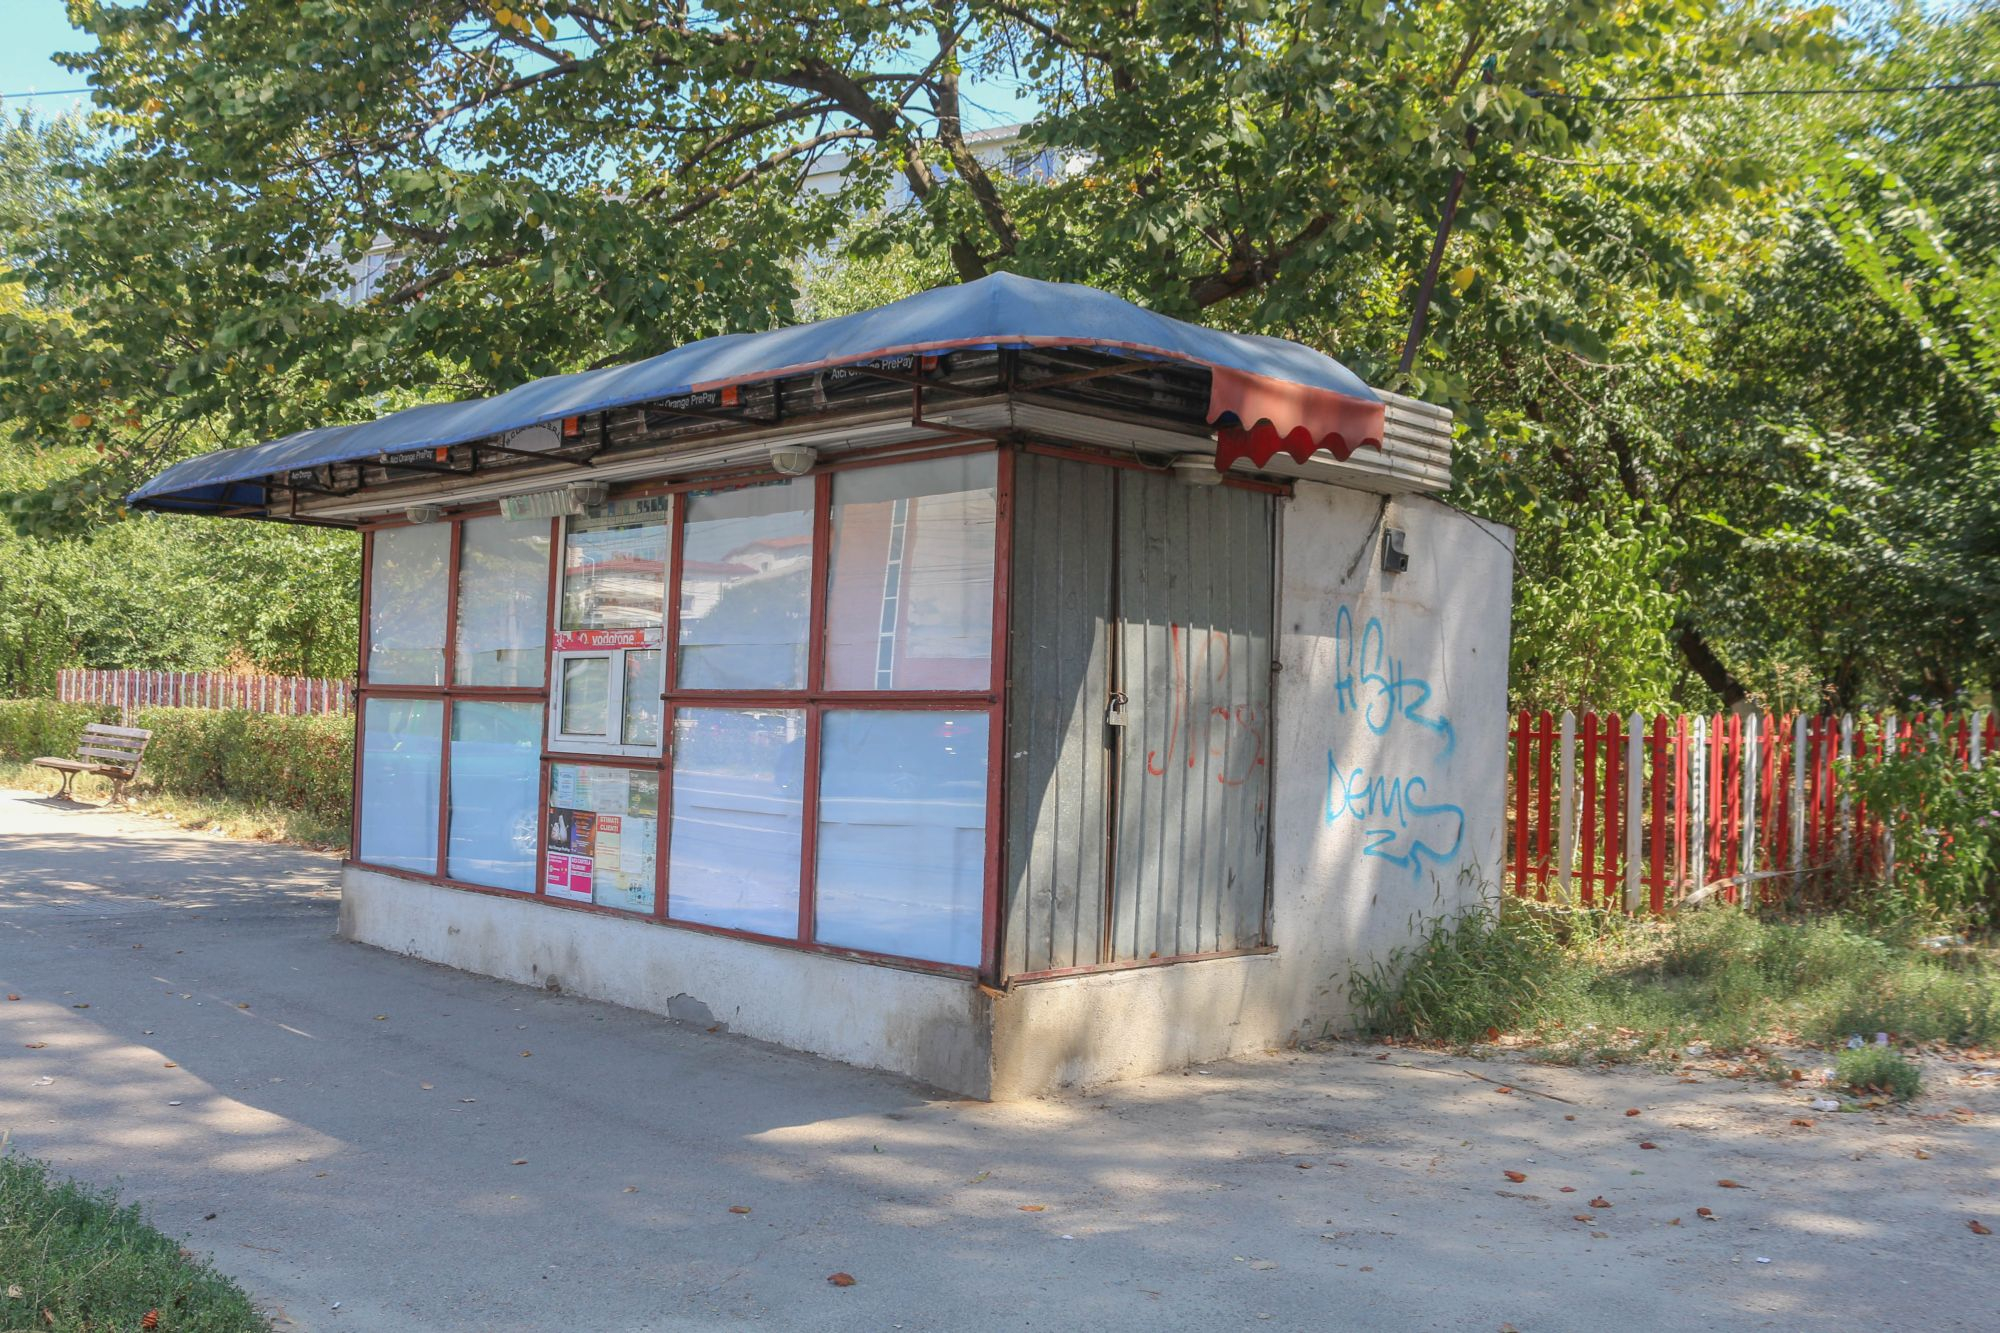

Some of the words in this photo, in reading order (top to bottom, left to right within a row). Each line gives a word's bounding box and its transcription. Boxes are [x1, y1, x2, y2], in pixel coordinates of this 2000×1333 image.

[881, 356, 914, 371] PrePay
[664, 397, 690, 410] Orange
[690, 392, 716, 406] PrePay
[399, 453, 415, 463] Orange
[416, 449, 433, 459] PrePay
